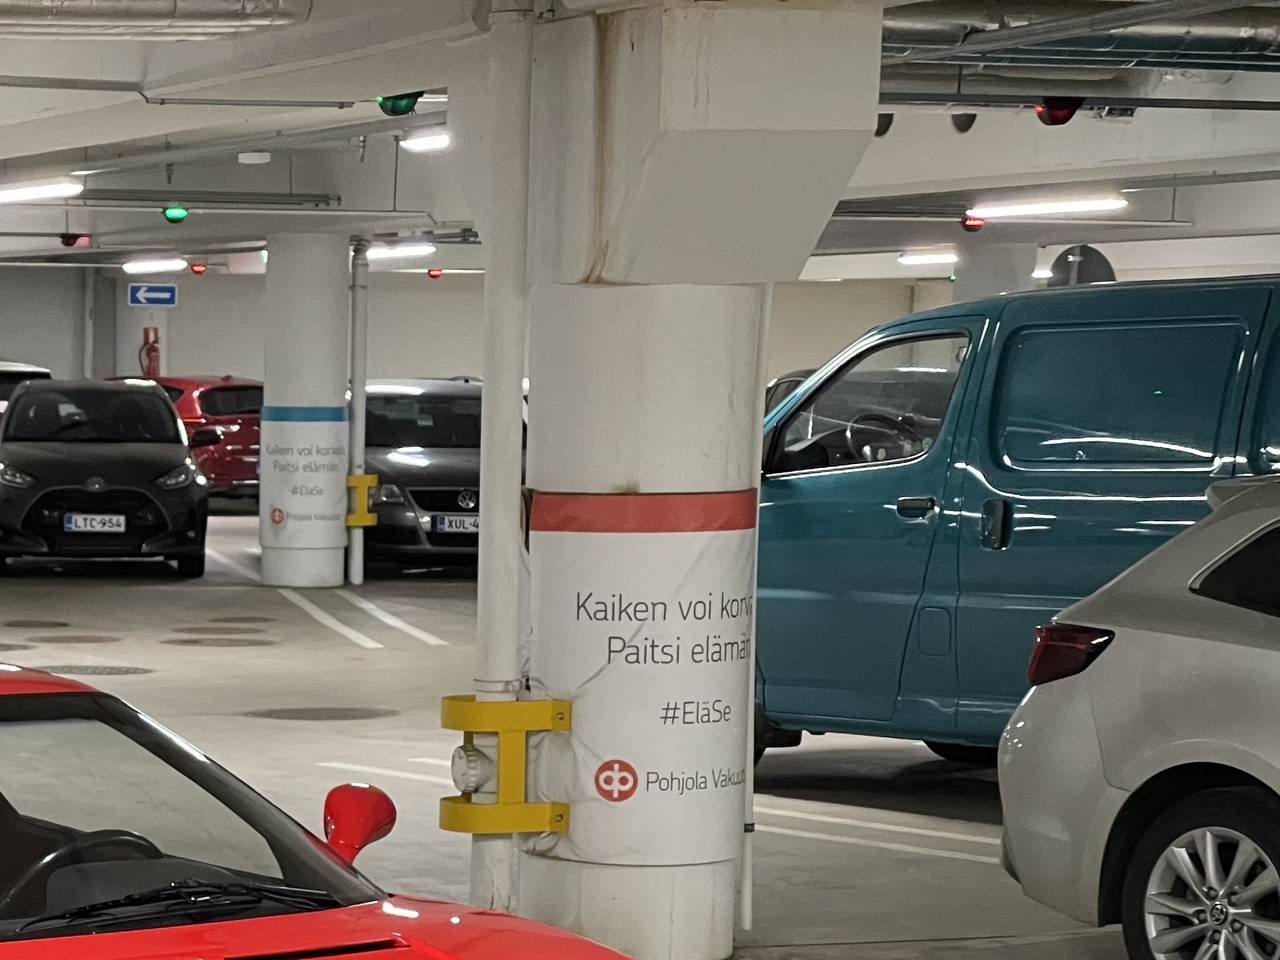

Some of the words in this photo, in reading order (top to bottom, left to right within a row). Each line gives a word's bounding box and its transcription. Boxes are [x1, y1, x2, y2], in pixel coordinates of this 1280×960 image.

[74, 517, 122, 529] LTC-954
[576, 592, 667, 622] Kaiken
[678, 592, 712, 620] voi
[607, 636, 680, 665] Paitsi
[660, 699, 732, 725] #EläSe
[646, 771, 708, 796] Pohjola
